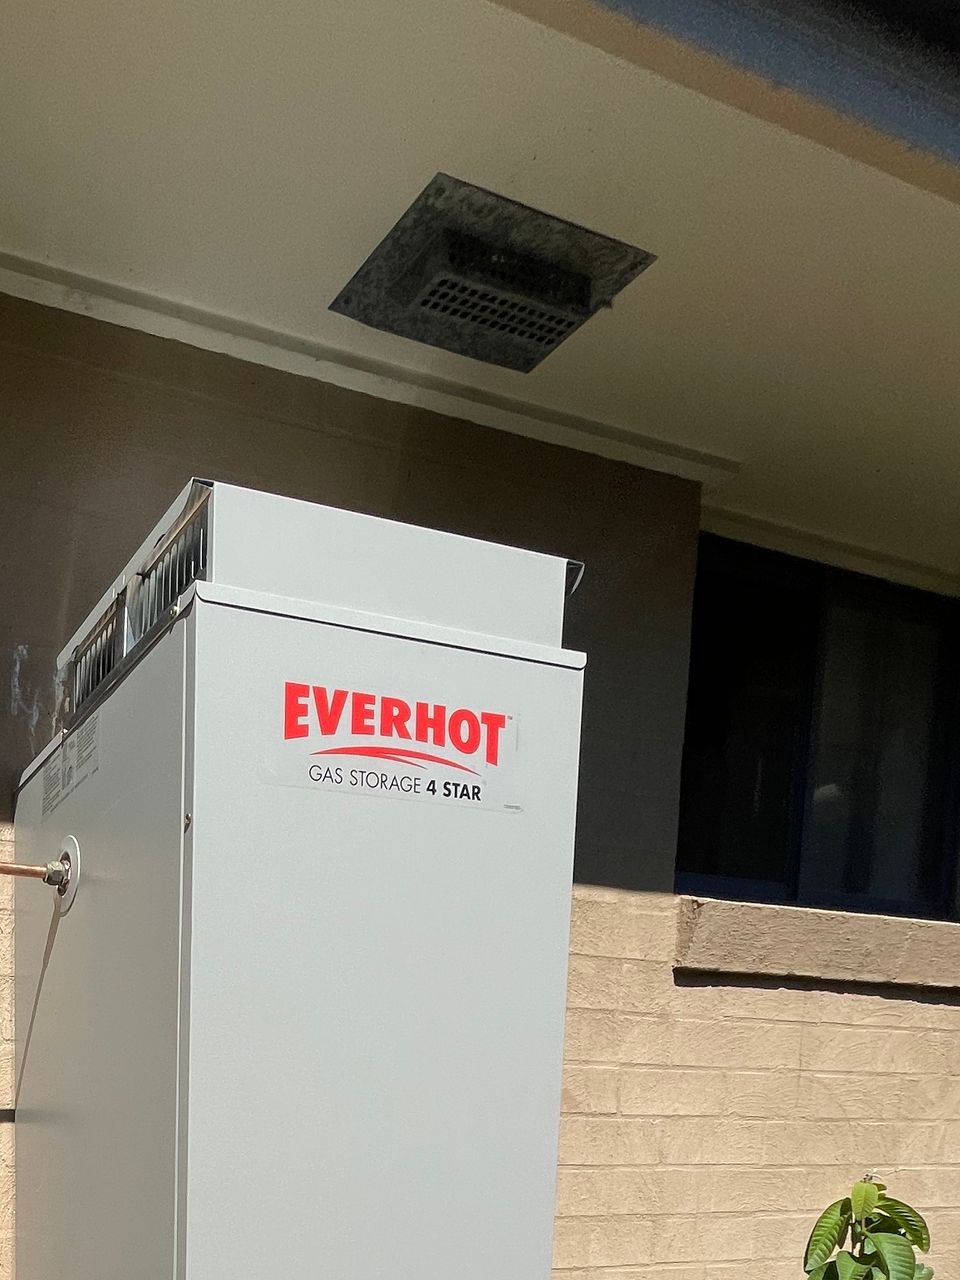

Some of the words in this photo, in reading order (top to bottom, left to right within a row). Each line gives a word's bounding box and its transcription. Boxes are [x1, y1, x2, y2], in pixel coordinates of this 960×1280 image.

[284, 681, 506, 766] EVERHOT
[308, 764, 343, 784] GAS
[350, 769, 421, 794] STORAGE
[426, 779, 437, 796] 4
[442, 780, 481, 801] STAR
